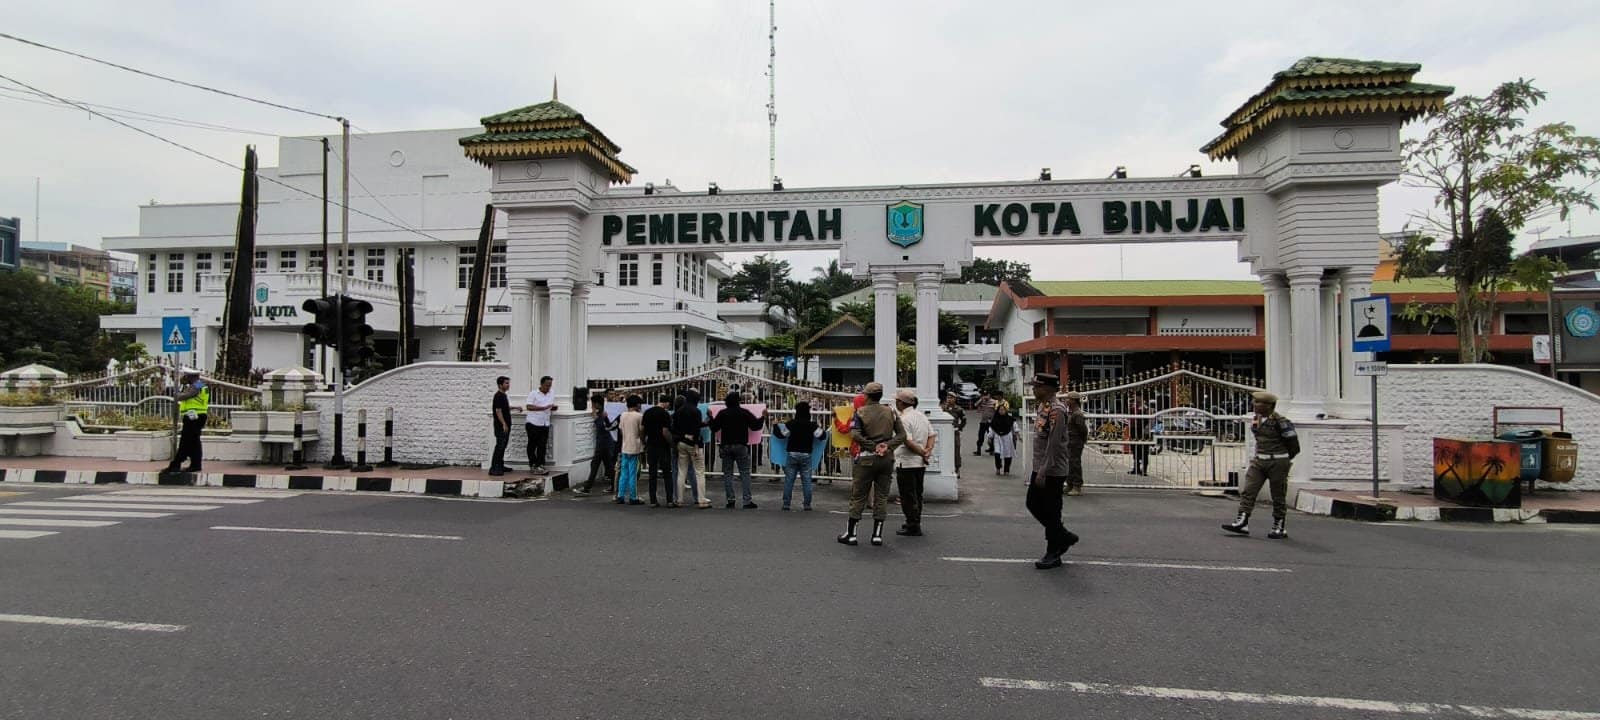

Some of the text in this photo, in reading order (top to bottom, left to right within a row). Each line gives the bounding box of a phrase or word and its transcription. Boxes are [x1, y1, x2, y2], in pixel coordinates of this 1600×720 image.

[602, 208, 842, 245] PEMERINTAH
[974, 197, 1245, 236] KOTA BINJAI
[266, 305, 298, 317] KOTA
